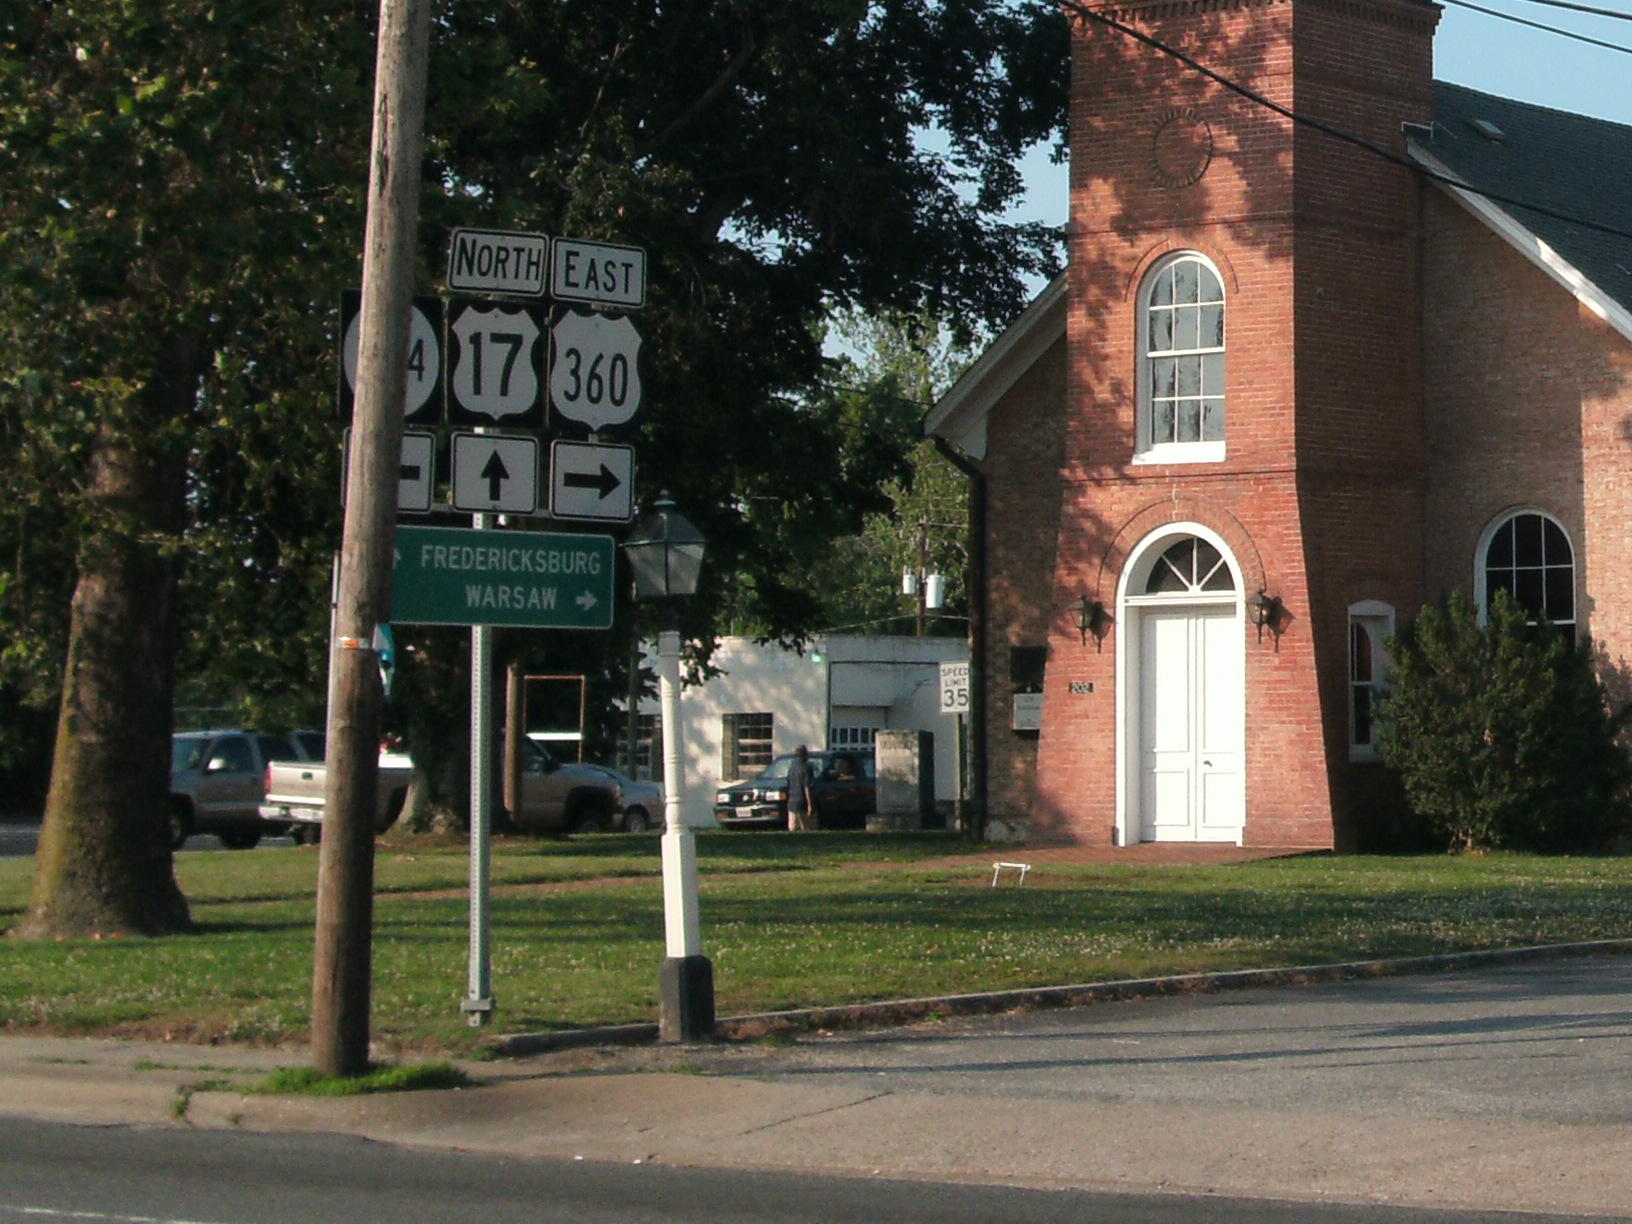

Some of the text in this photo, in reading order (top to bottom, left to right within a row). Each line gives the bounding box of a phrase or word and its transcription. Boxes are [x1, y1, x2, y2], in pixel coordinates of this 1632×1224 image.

[456, 238, 542, 281] NORTH
[564, 250, 634, 295] EAST
[469, 331, 524, 397] 17
[563, 347, 628, 407] 360
[421, 544, 601, 575] FREDERICKSBURG
[465, 584, 558, 610] WARSAW
[941, 667, 970, 676] SPEED
[944, 677, 967, 687] LIMIT
[944, 688, 969, 707] 35
